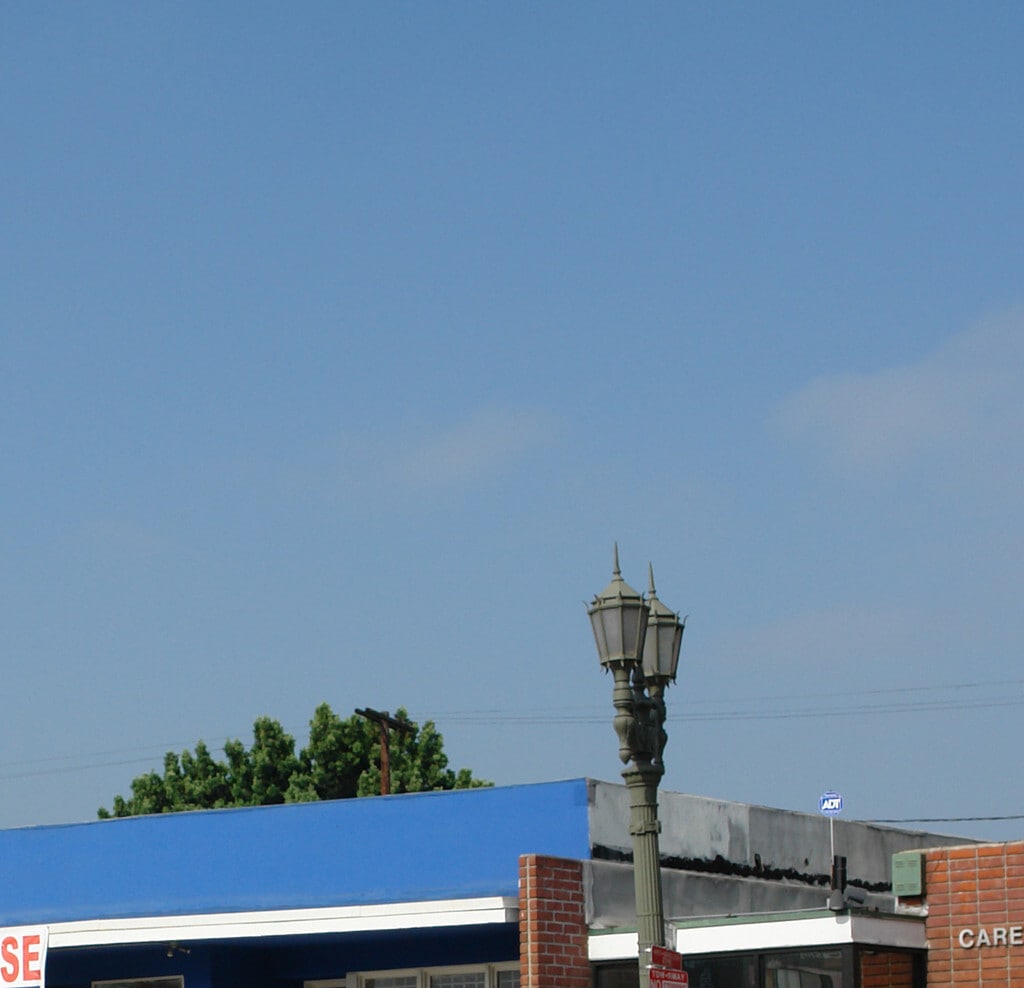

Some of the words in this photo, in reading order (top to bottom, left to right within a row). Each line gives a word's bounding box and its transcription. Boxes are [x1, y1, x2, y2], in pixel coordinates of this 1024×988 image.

[822, 798, 841, 810] ADT
[958, 926, 1024, 949] CARE
[651, 970, 686, 981] TOW-AWAY
